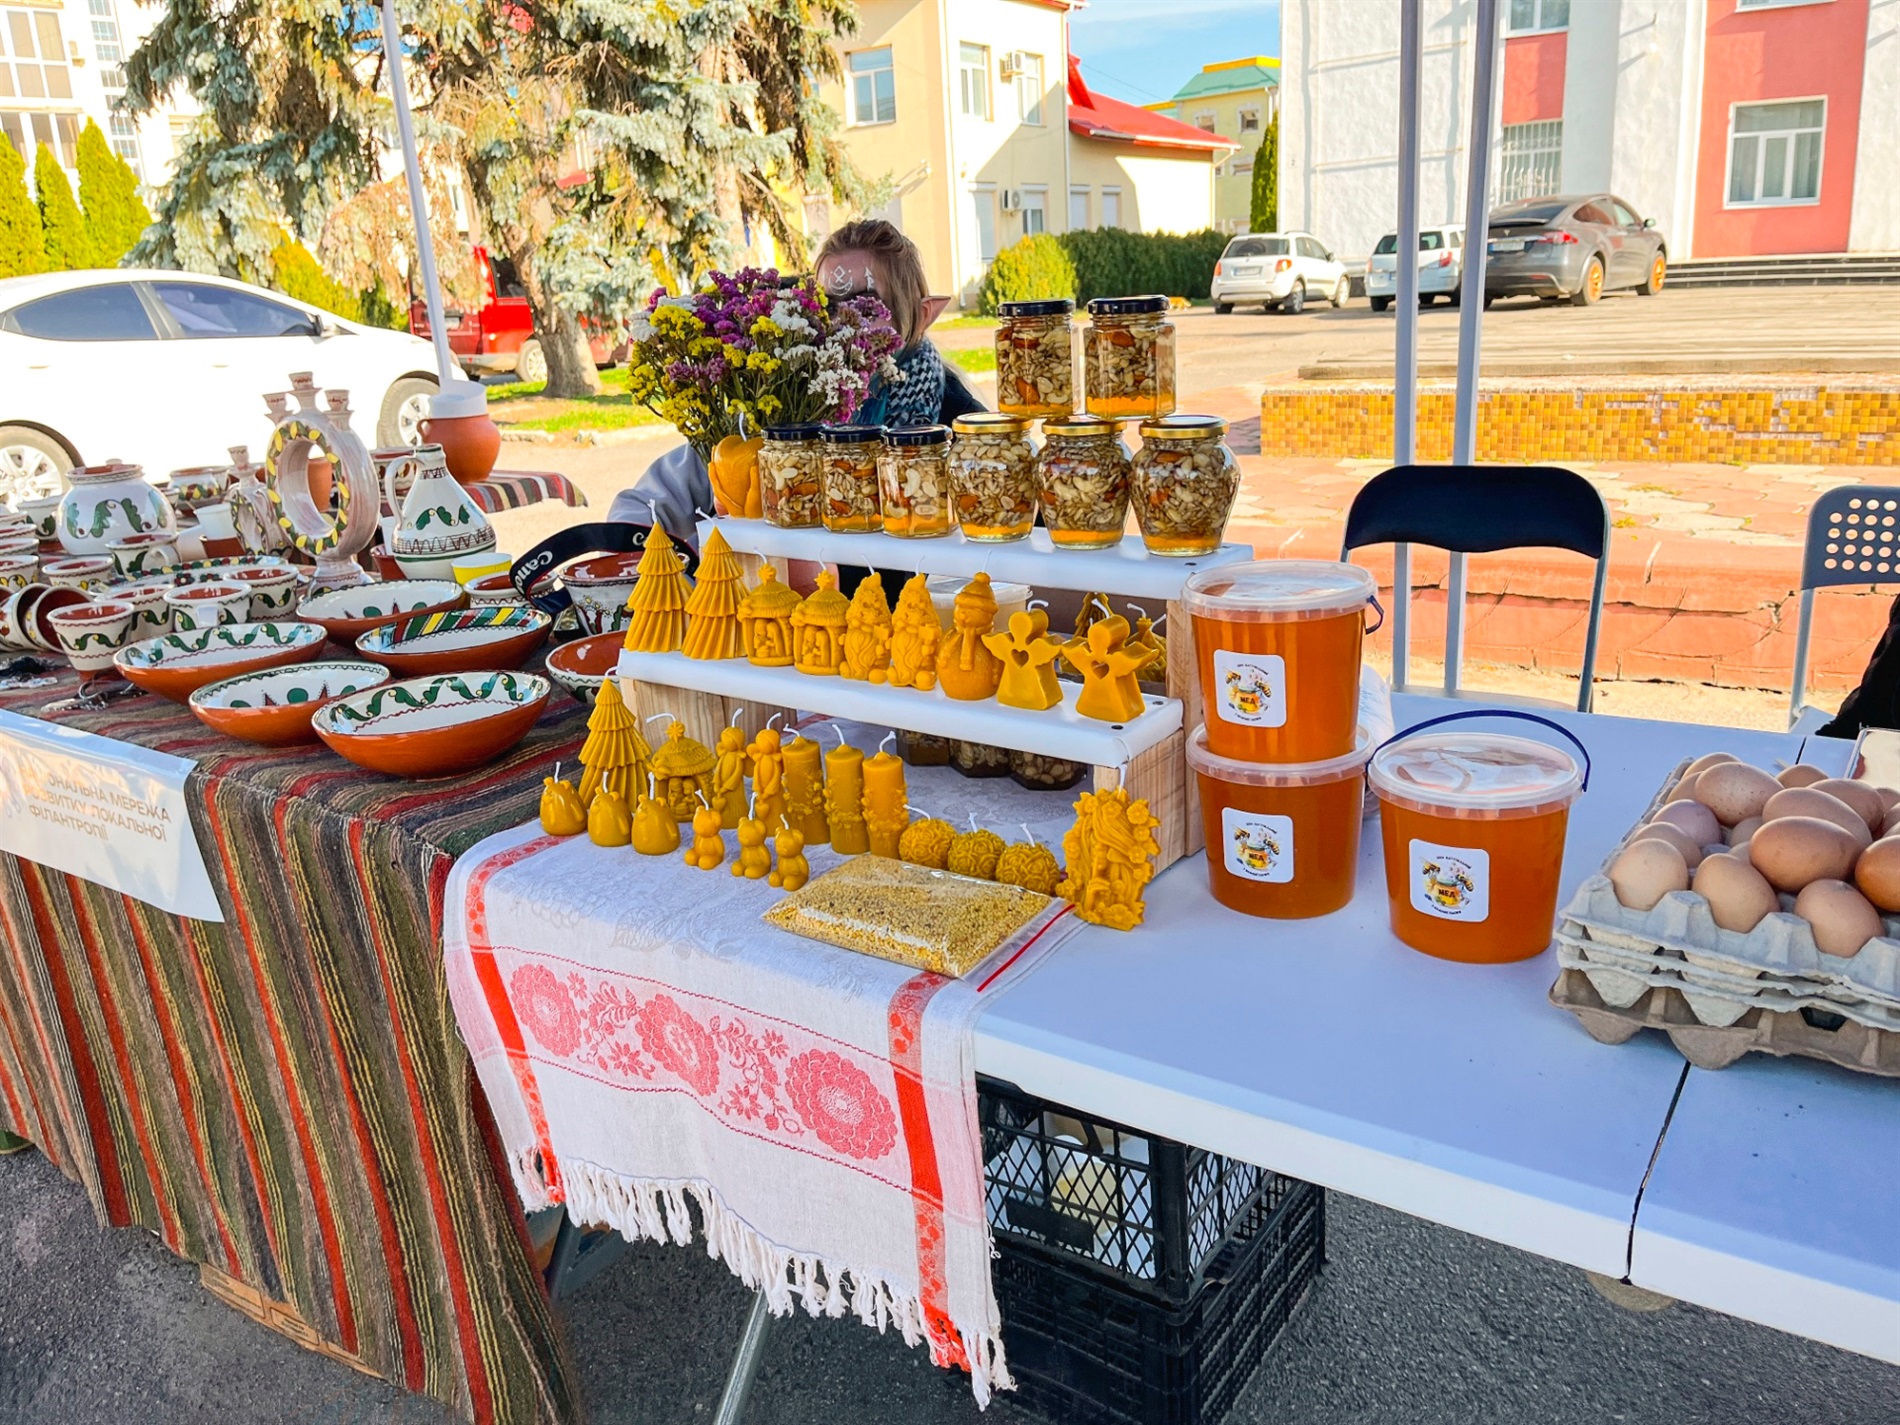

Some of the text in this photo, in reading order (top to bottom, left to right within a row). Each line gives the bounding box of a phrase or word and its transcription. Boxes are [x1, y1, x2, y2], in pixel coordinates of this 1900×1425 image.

[28, 804, 109, 841] ФІЛАНТРОПІЇ
[91, 804, 167, 842] ЛОКАЛЬНОЇ
[110, 791, 171, 823] МЕРЕЖА
